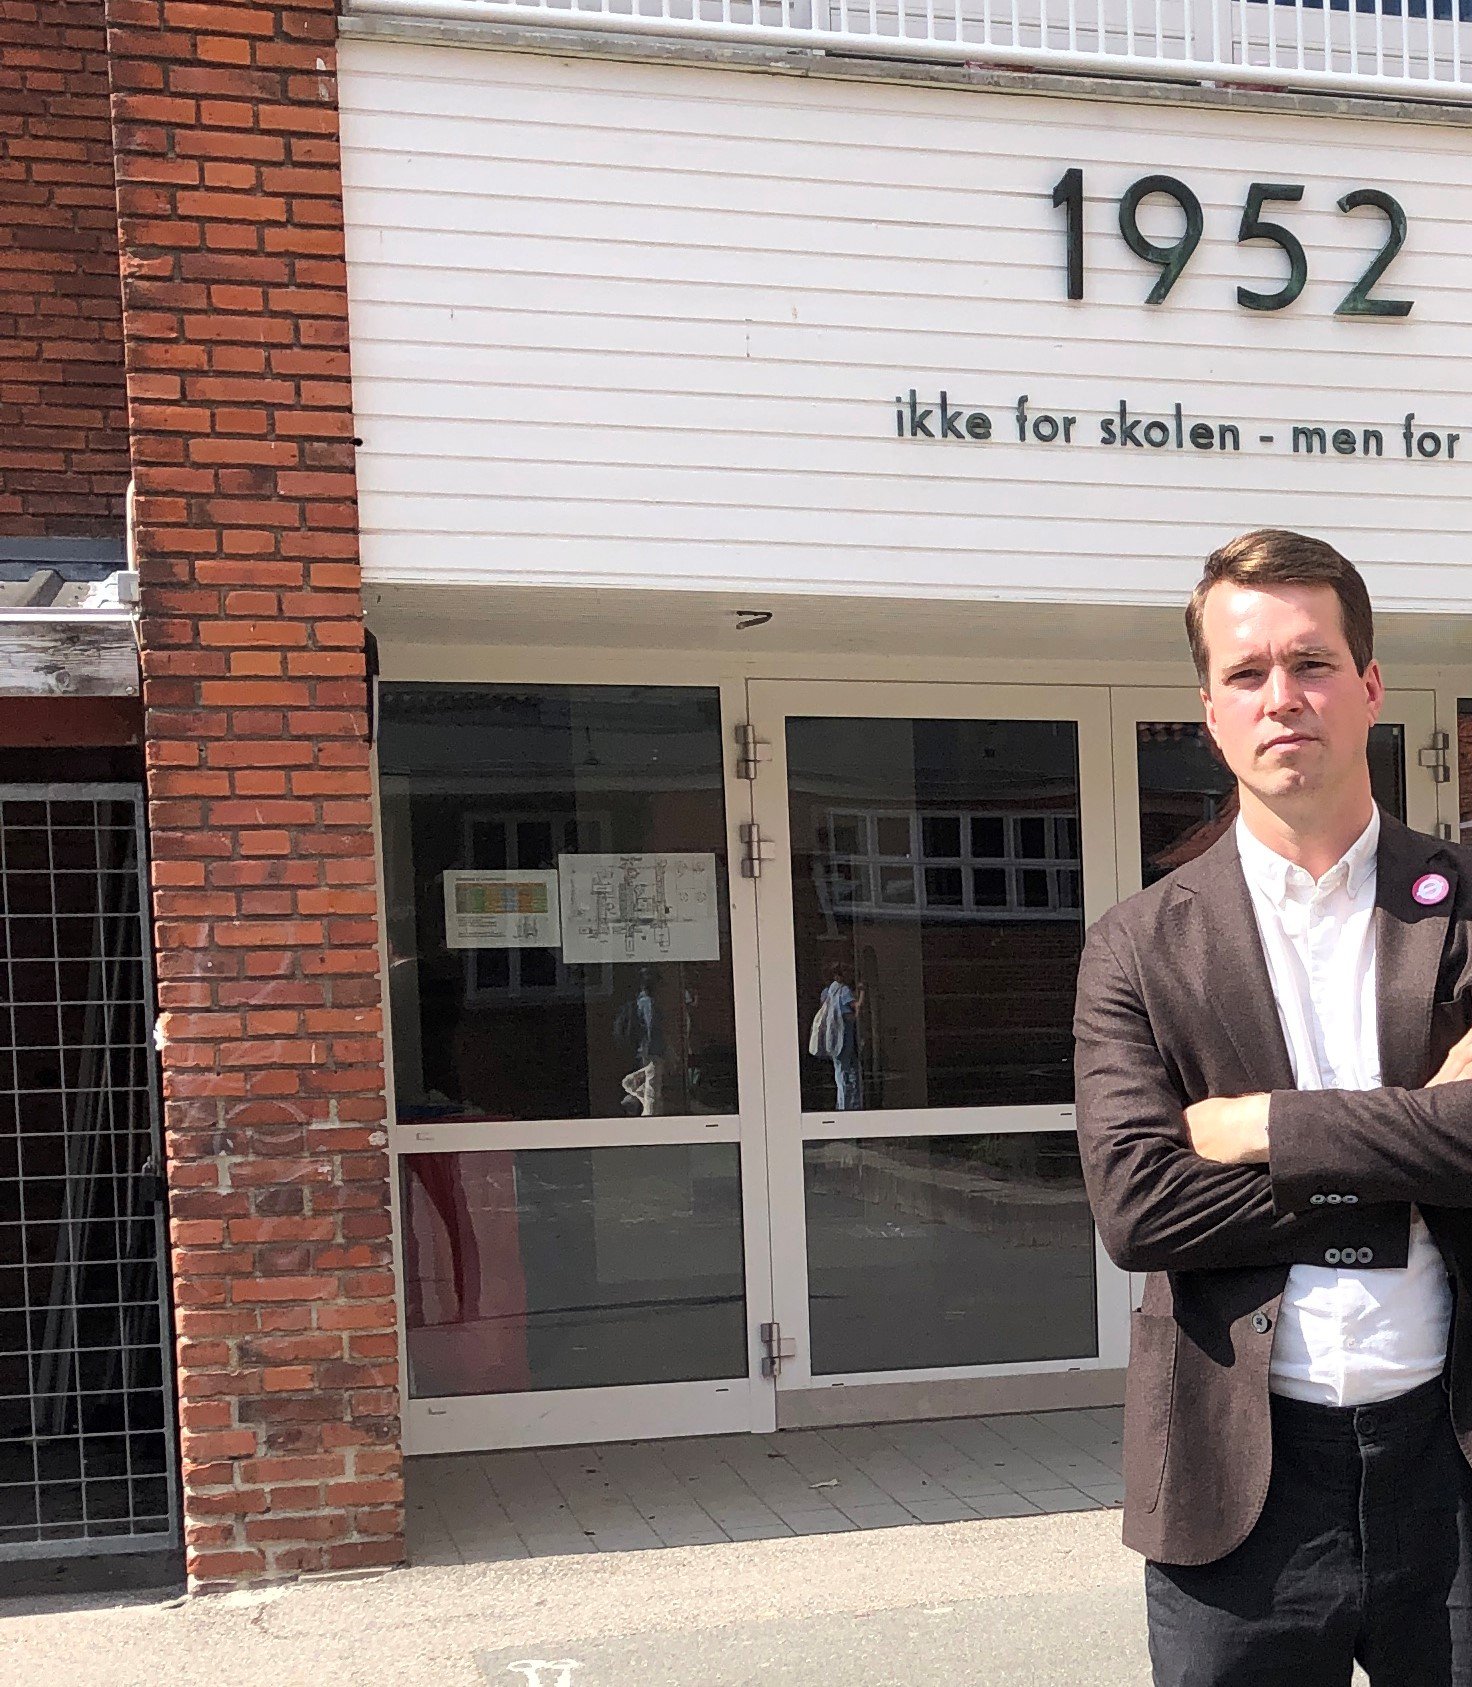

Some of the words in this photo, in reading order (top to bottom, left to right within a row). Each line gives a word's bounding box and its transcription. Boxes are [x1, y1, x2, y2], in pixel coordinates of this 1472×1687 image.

[1050, 167, 1415, 317] 1952
[895, 389, 992, 440] ikke
[1015, 395, 1077, 444] for
[1100, 399, 1240, 451] skolen
[1292, 426, 1383, 457] men
[1402, 412, 1460, 459] for
